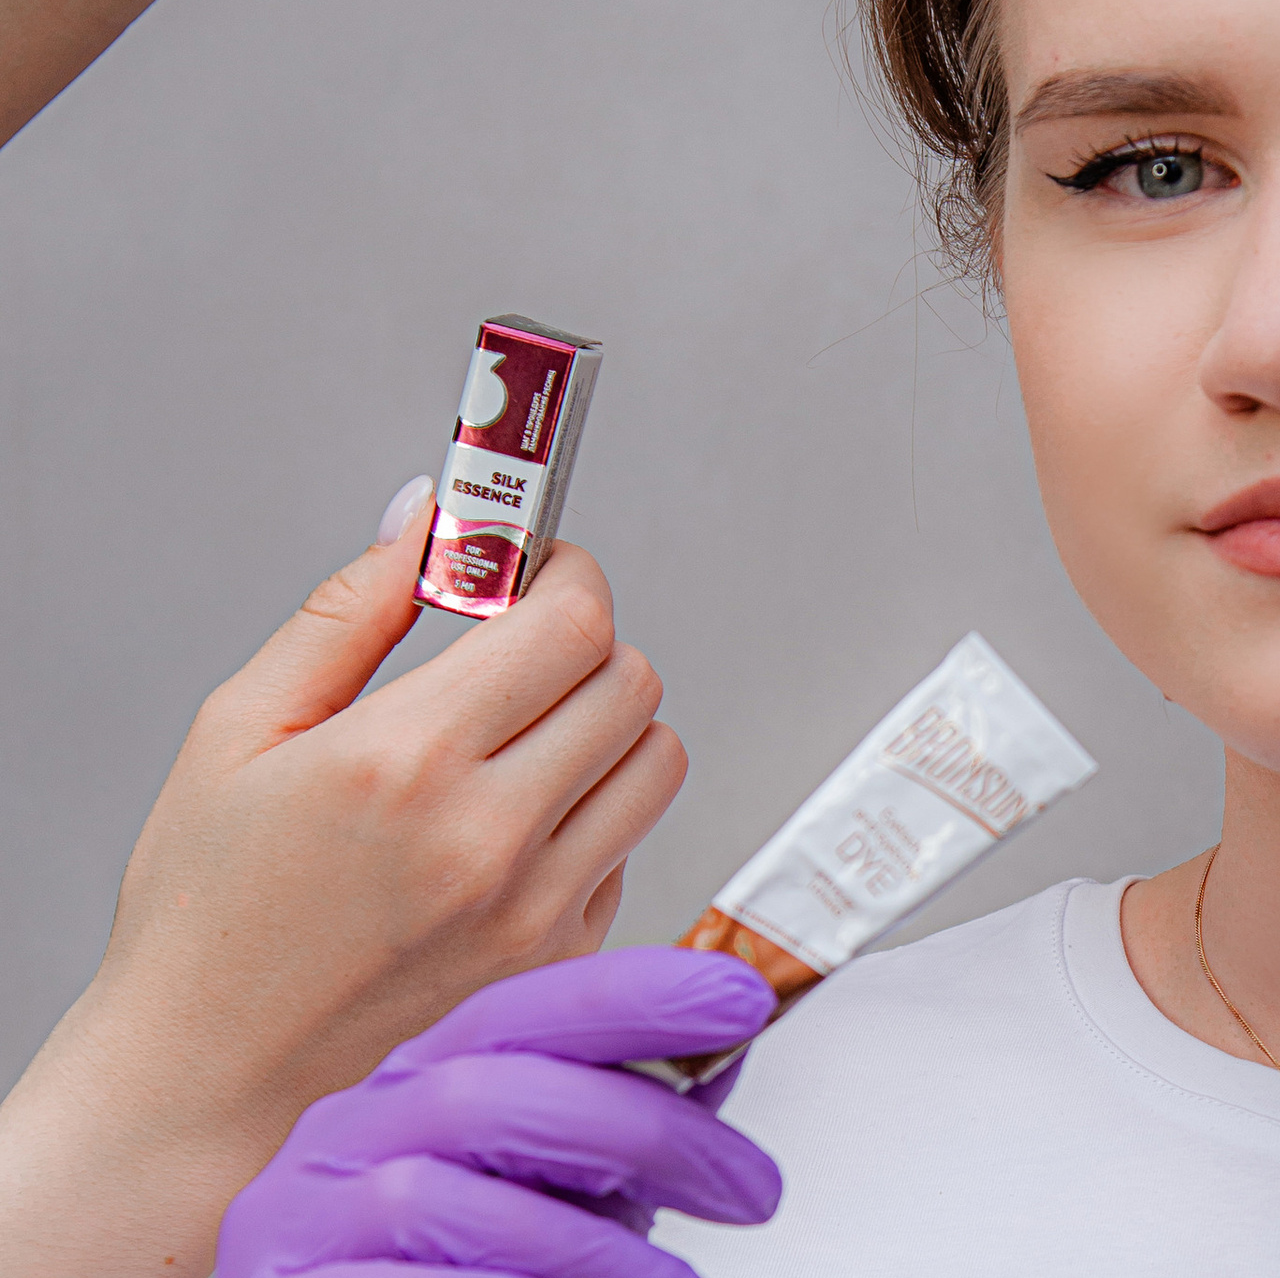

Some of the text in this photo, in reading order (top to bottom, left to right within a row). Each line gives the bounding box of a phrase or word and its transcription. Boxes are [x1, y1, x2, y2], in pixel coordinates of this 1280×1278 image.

[452, 478, 523, 509] ESSENCE
[491, 471, 528, 493] SILK
[444, 549, 499, 573] PROFESSIONAL
[465, 544, 482, 557] FOR
[450, 561, 487, 579] USE ONLY
[835, 831, 899, 898] DYE
